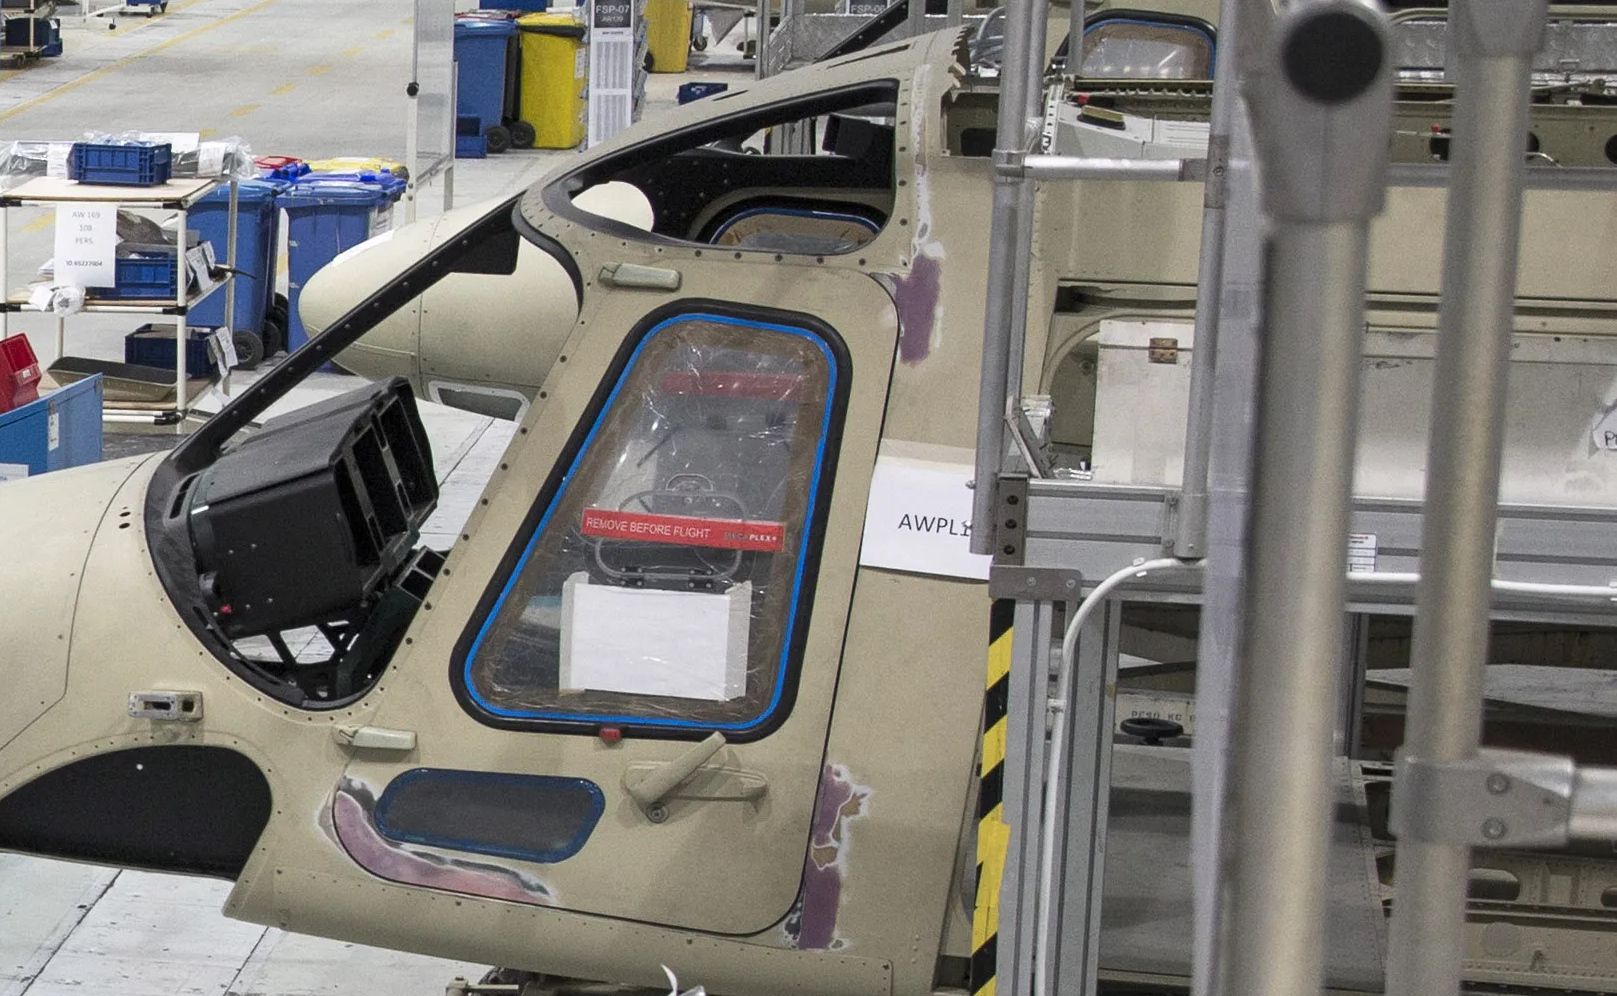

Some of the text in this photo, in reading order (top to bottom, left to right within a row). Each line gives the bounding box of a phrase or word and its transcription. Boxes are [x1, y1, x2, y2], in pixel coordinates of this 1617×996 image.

[595, 4, 630, 14] FSP-07
[586, 516, 712, 540] REMOVE BEFORE FLIGHT
[1168, 712, 1183, 722] KG
